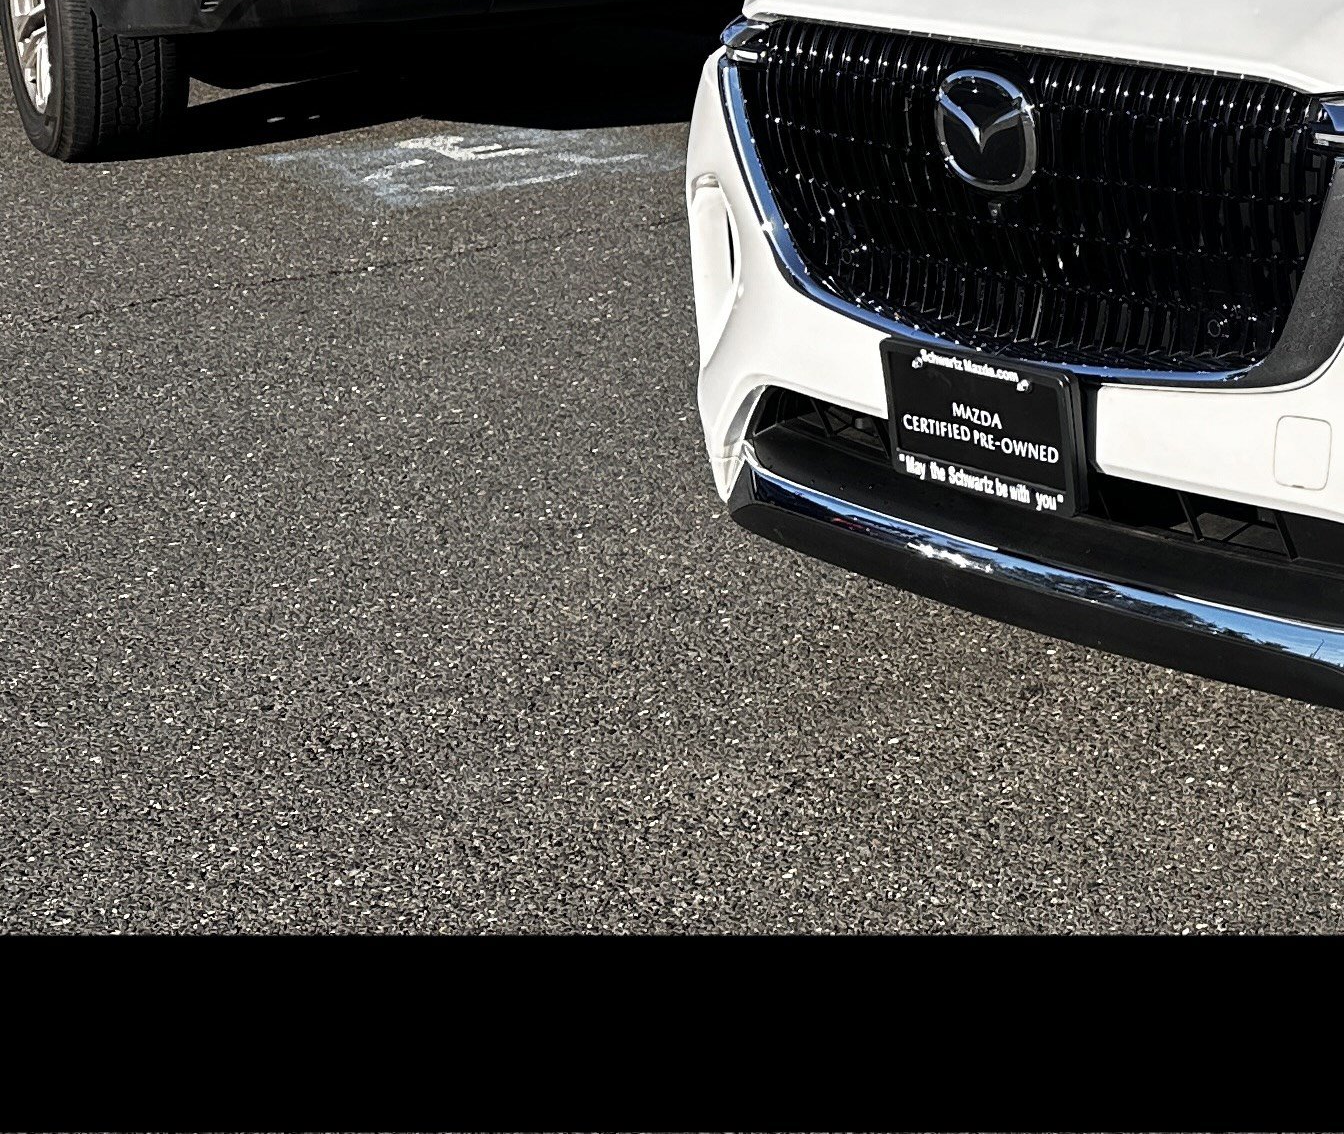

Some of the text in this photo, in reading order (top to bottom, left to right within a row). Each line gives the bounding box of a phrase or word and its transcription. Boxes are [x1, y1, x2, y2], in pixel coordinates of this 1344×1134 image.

[952, 402, 1003, 430] MAZDA
[903, 414, 1060, 464] CERTIFIED PRE-OWNED
[930, 461, 946, 482] the
[948, 466, 994, 495] Schwartz
[995, 479, 1009, 499] be
[1009, 483, 1031, 504] with
